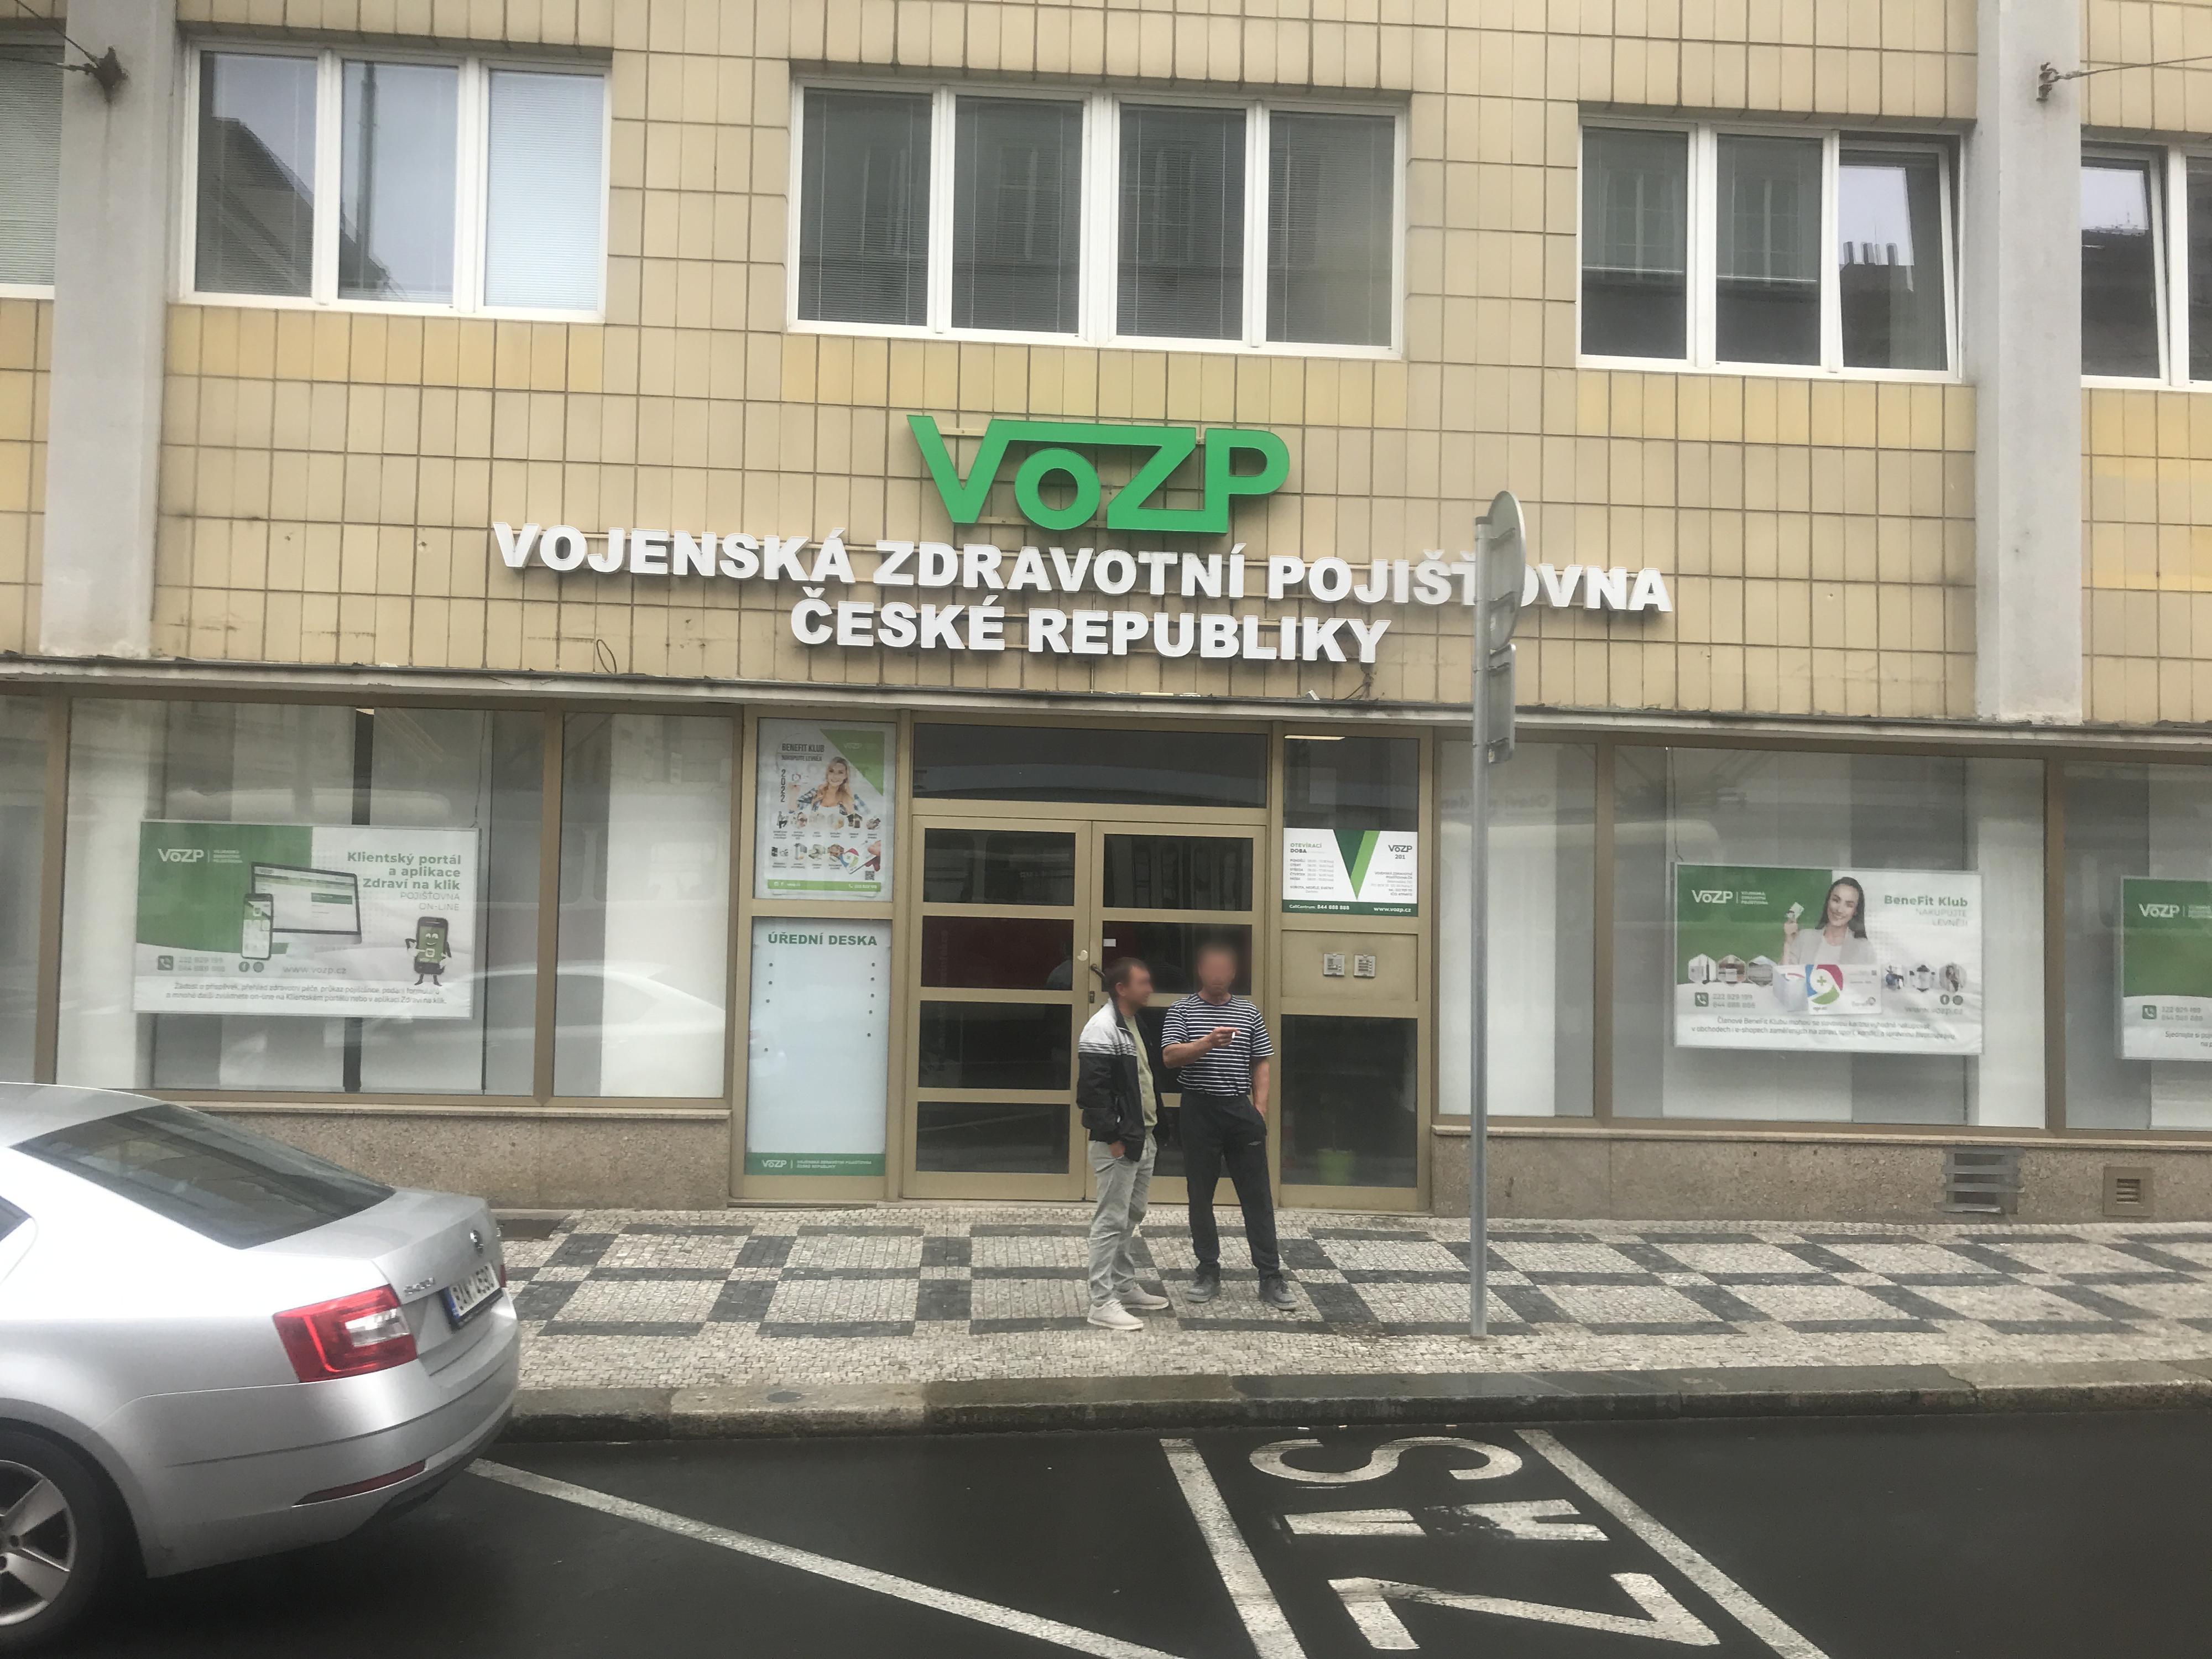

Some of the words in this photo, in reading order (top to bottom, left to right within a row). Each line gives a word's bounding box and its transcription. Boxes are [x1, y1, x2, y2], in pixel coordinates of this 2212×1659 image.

[907, 414, 1290, 534] VoZP
[492, 522, 853, 585] VOJENSKÁ
[873, 542, 1248, 599] ZDRAVOTNÍ
[790, 585, 1006, 653] ČESKÉ
[1027, 607, 1390, 665] REPUBLIKY
[782, 743, 807, 752] BENEFIT
[157, 848, 204, 862] VoZP
[347, 852, 414, 865] Klientský
[419, 855, 461, 866] portál
[389, 868, 397, 876] a
[401, 866, 460, 878] aplikace
[363, 878, 408, 889] Zdraví
[413, 881, 429, 889] na
[434, 879, 460, 890] klik
[400, 891, 460, 900] POJIŠŤOVNA
[1691, 890, 1733, 904] VoZP
[1884, 895, 1934, 905] BeneFit
[1938, 896, 1968, 906] Klub
[419, 903, 460, 911] ON-LINE
[2138, 903, 2180, 918] VoZP
[768, 931, 823, 945] ÚŘEDNÍ
[828, 934, 877, 946] DESKA
[762, 1160, 787, 1168] VoZP
